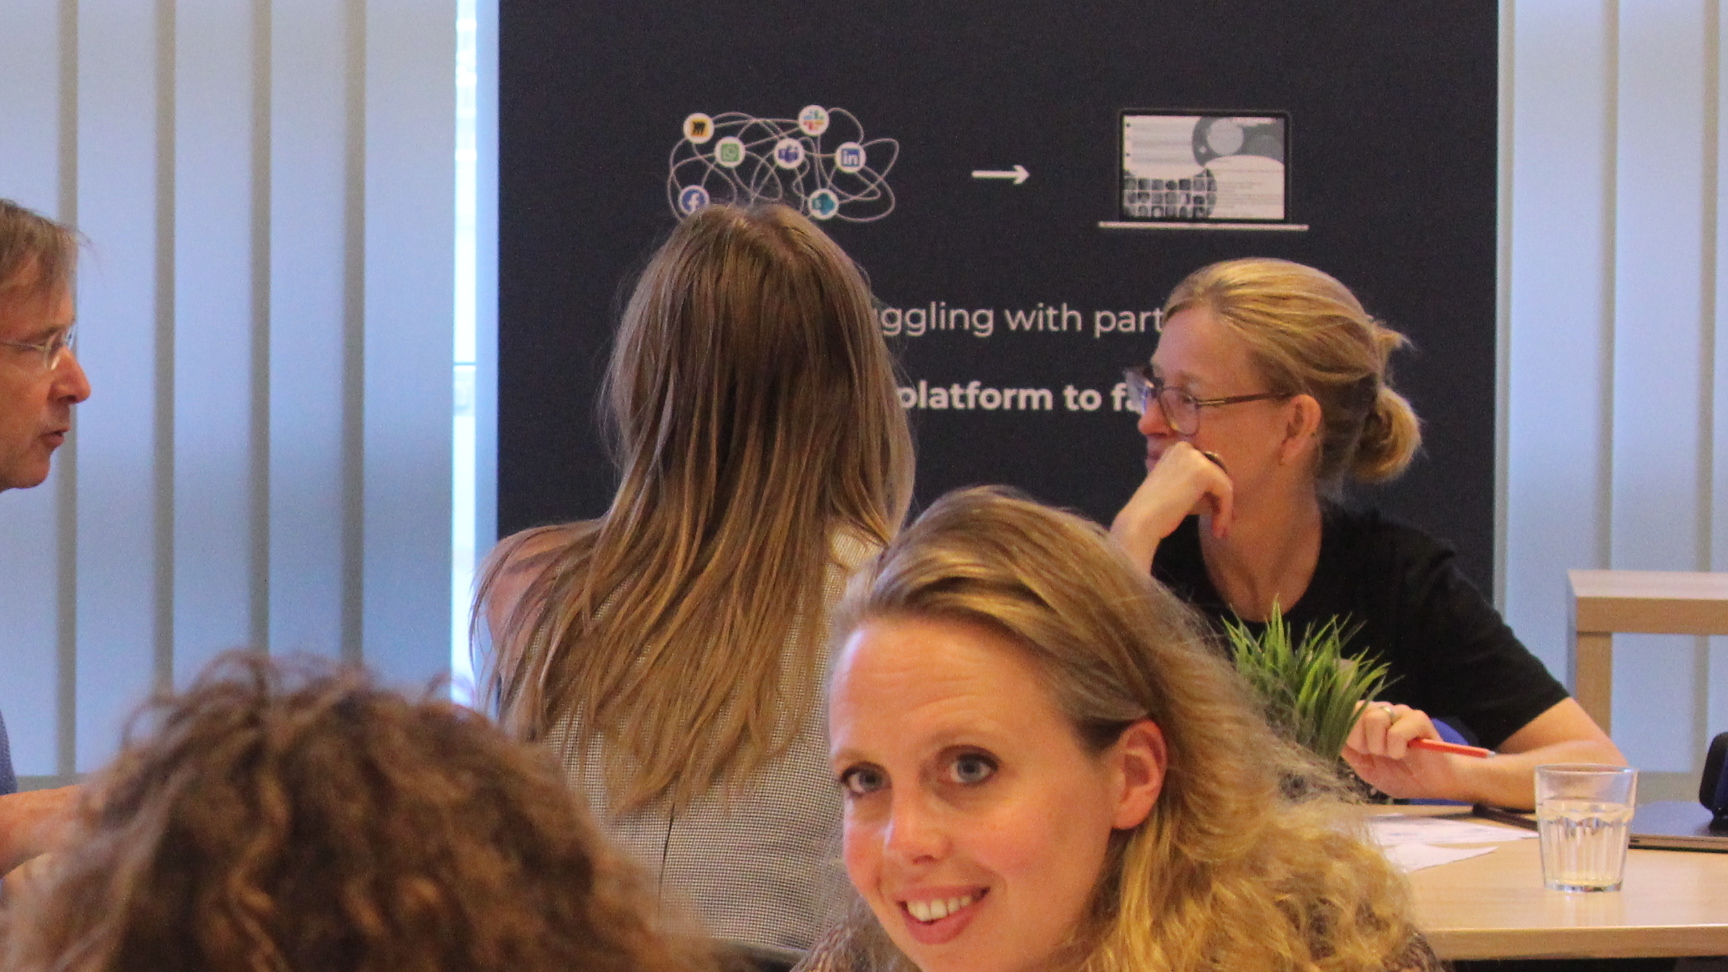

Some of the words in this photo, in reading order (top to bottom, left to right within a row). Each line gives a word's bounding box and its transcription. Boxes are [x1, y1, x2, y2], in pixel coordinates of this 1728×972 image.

[872, 301, 995, 336] ggling
[1004, 303, 1082, 331] with
[1094, 307, 1164, 338] part
[1063, 384, 1102, 411] to
